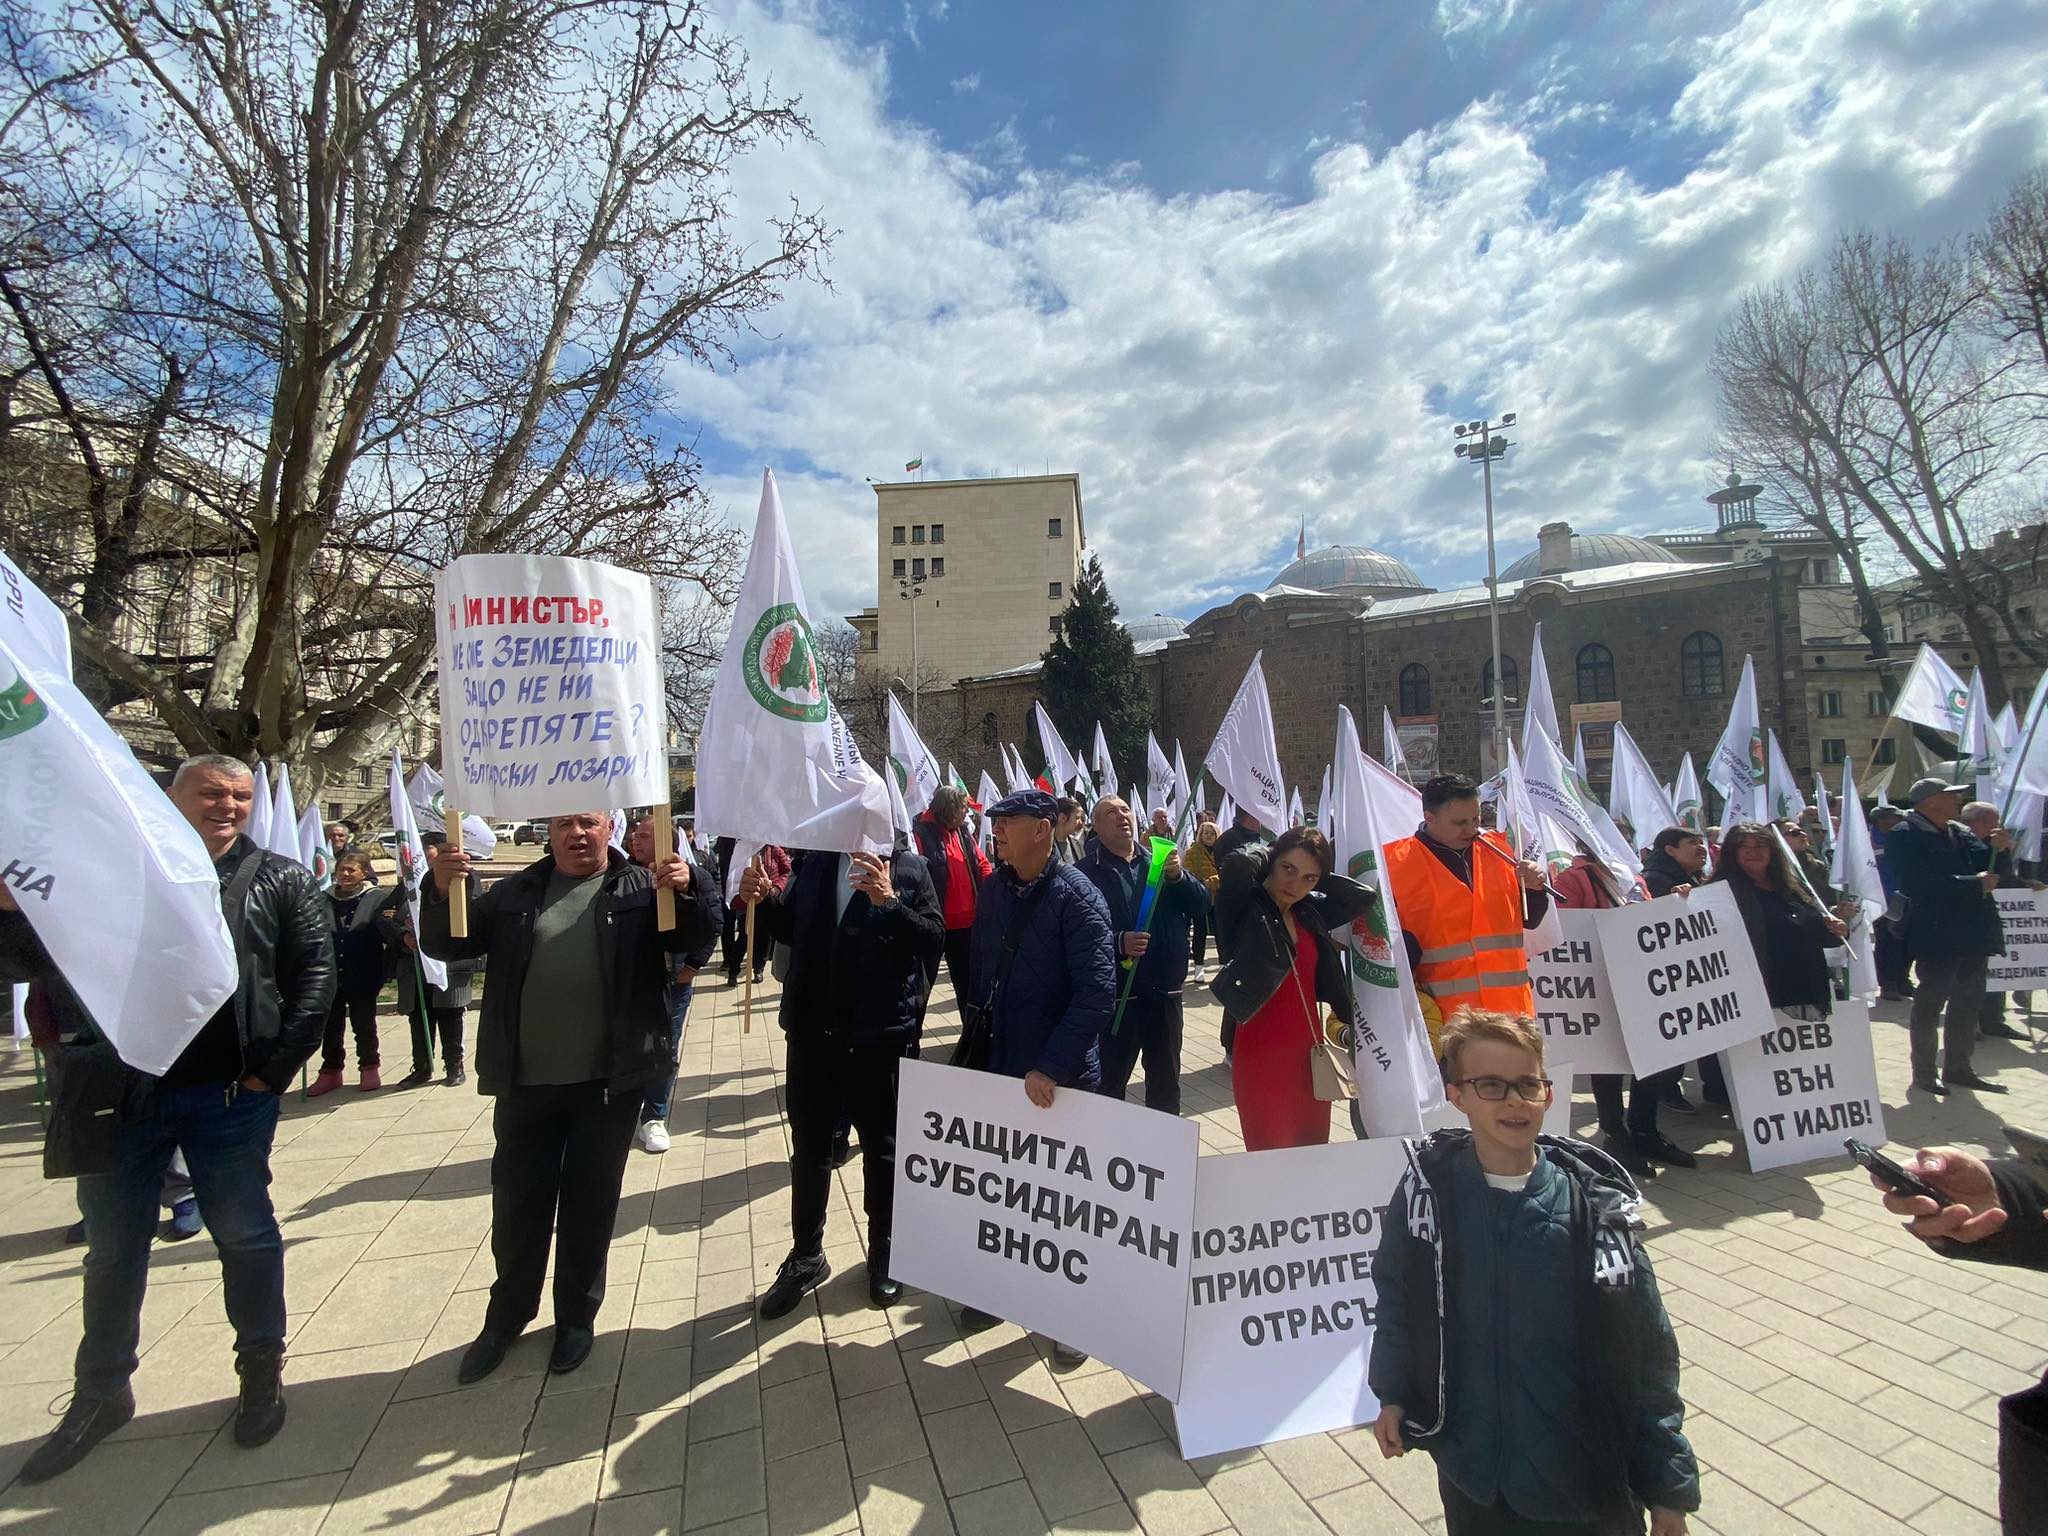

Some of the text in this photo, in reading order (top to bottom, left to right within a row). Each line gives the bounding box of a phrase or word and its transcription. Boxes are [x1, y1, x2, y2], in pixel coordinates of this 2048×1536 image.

[492, 634, 638, 673] ЗЕМЕДЕЛЦИ
[517, 676, 550, 704] НЕ
[559, 674, 593, 702] НИ
[547, 754, 637, 791] ЛОЗАРИ
[2, 859, 55, 900] НА
[1637, 909, 1718, 953] СРАМ!
[1647, 950, 1729, 996] СРАМ!
[2010, 951, 2019, 961] В
[1538, 1013, 1601, 1036] ТЪР
[1658, 992, 1741, 1041] СРАМ!
[1371, 1046, 1392, 1072] НА
[1760, 1022, 1833, 1056] КОЕВ
[1773, 1063, 1835, 1096] ВЪН
[1753, 1099, 1873, 1144] ОТ ИАЛВ!
[922, 1110, 1165, 1201] ЗАЩИТА ОТ
[904, 1152, 1181, 1268] СУБСИДИРАН
[977, 1219, 1089, 1285] ВНОС
[1191, 1250, 1376, 1306] ПРИОРИТЕ
